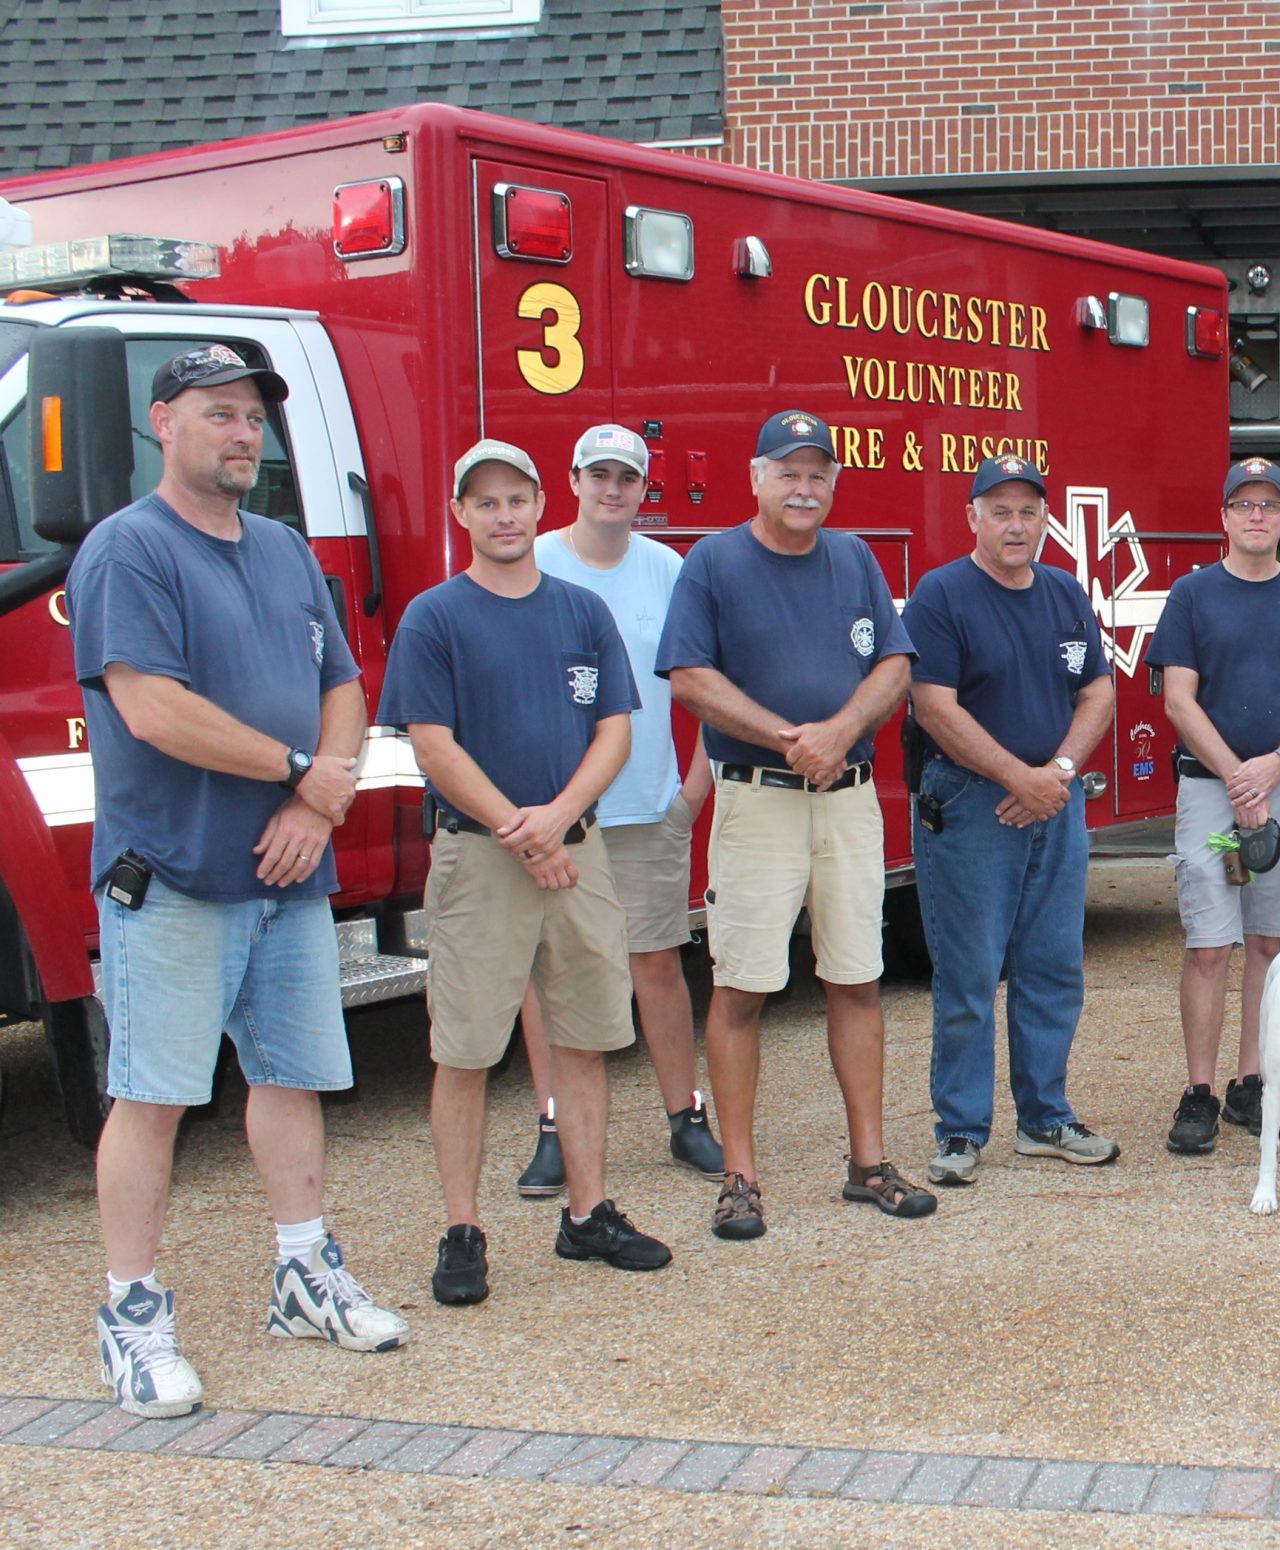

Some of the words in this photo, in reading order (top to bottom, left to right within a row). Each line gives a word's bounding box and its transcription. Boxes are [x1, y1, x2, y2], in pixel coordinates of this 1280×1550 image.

[515, 281, 586, 395] 3
[804, 273, 1051, 351] GLOUCESTER
[843, 355, 1023, 411] VOLUNTEER
[829, 425, 886, 470] IRE
[902, 430, 924, 472] &
[1133, 760, 1154, 777] EMS
